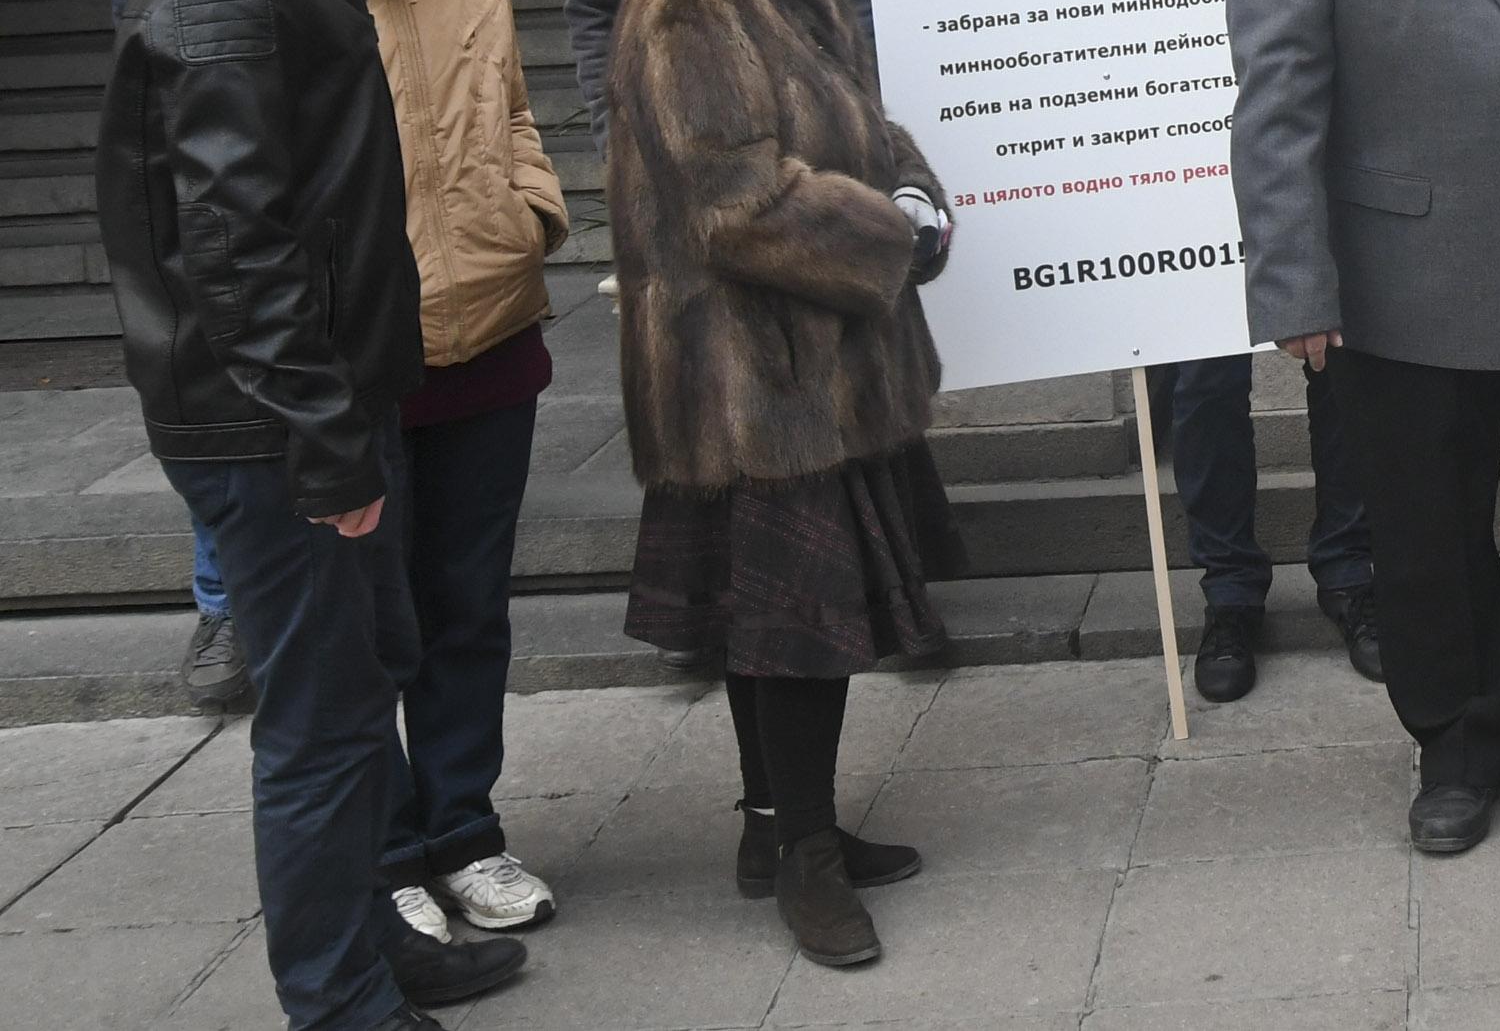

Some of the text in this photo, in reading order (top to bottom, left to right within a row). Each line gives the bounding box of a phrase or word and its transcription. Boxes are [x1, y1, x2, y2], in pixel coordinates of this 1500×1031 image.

[936, 12, 1021, 34] забрана
[1026, 9, 1050, 24] за
[1055, 3, 1105, 21] нови
[939, 41, 1148, 77] миннообогатителни
[939, 99, 1003, 123] добив
[1007, 97, 1033, 113] на
[1038, 85, 1140, 110] подземни
[995, 136, 1067, 157] открит
[1071, 134, 1085, 149] и
[1090, 125, 1161, 147] закрит
[953, 163, 1230, 208] за цялото водно тяло река
